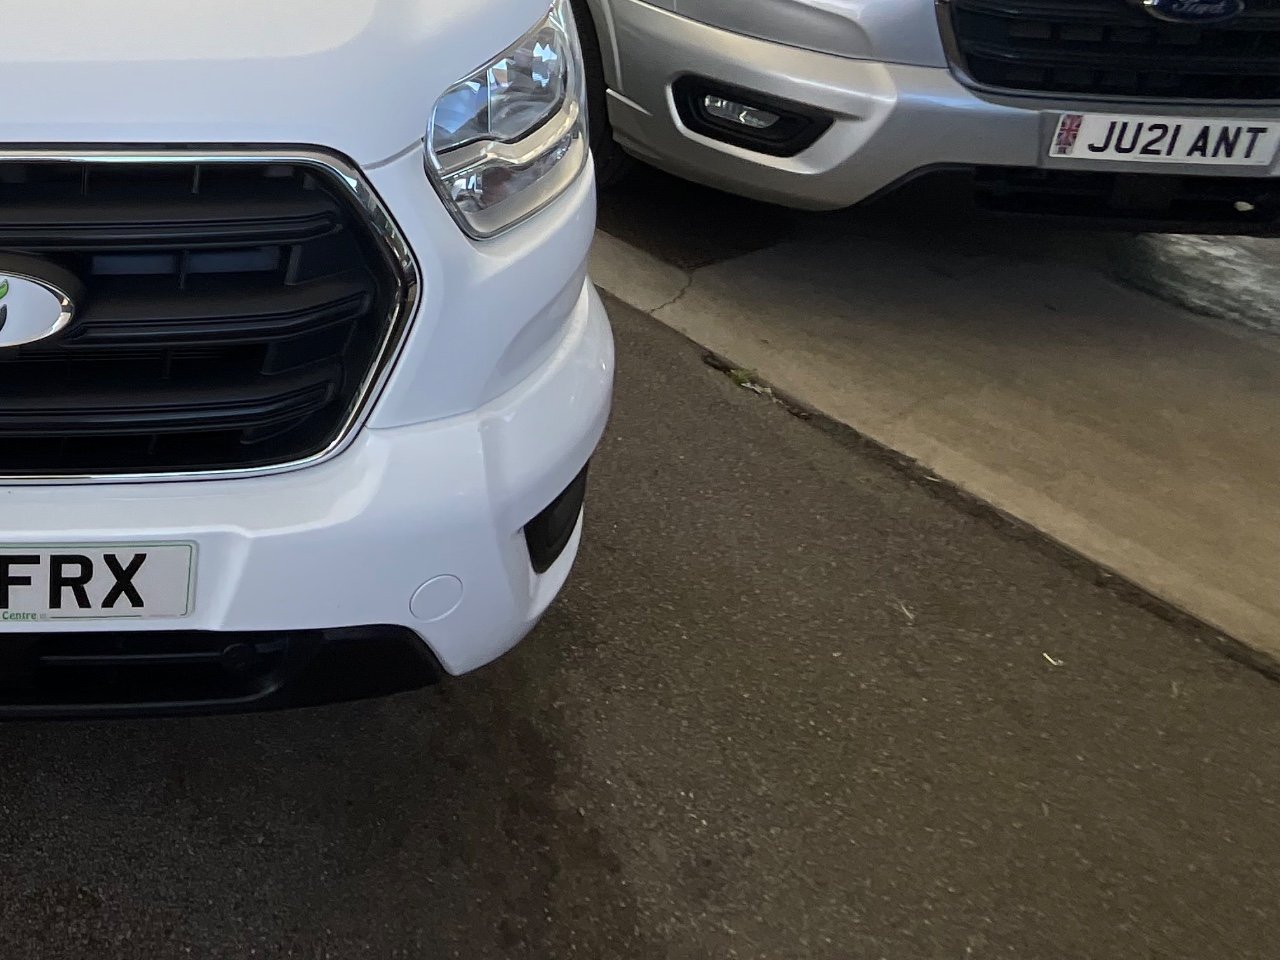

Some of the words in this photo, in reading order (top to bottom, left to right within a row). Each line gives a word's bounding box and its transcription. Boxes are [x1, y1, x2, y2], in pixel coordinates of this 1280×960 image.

[1088, 121, 1182, 157] JU21
[1186, 125, 1268, 159] ANT
[2, 610, 37, 620] Centre
